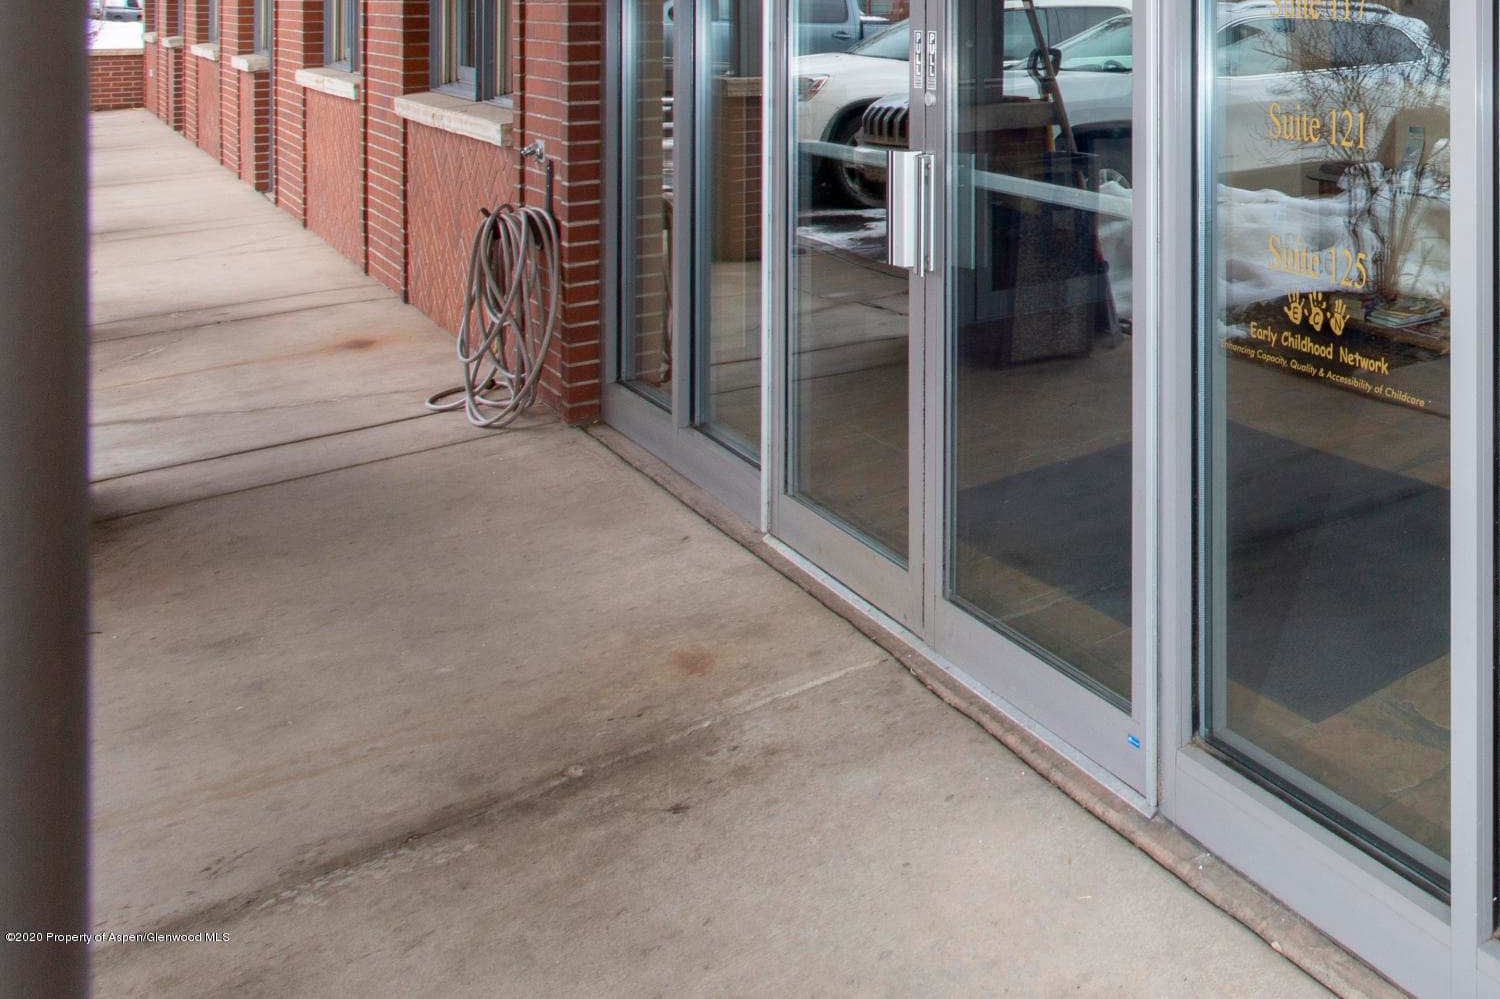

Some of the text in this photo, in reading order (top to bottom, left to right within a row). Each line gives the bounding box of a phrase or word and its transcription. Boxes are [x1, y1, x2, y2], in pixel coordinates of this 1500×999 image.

[1268, 102, 1366, 149] Suite 121
[1267, 233, 1367, 290] Suite 125
[1249, 321, 1390, 375] Early Childhood Network
[1256, 349, 1288, 367] Capacity,
[1290, 359, 1317, 376] Quality
[1319, 367, 1325, 377] &
[1326, 371, 1373, 393] Accessibility
[1374, 385, 1384, 394] of
[1384, 387, 1425, 407] Childcare
